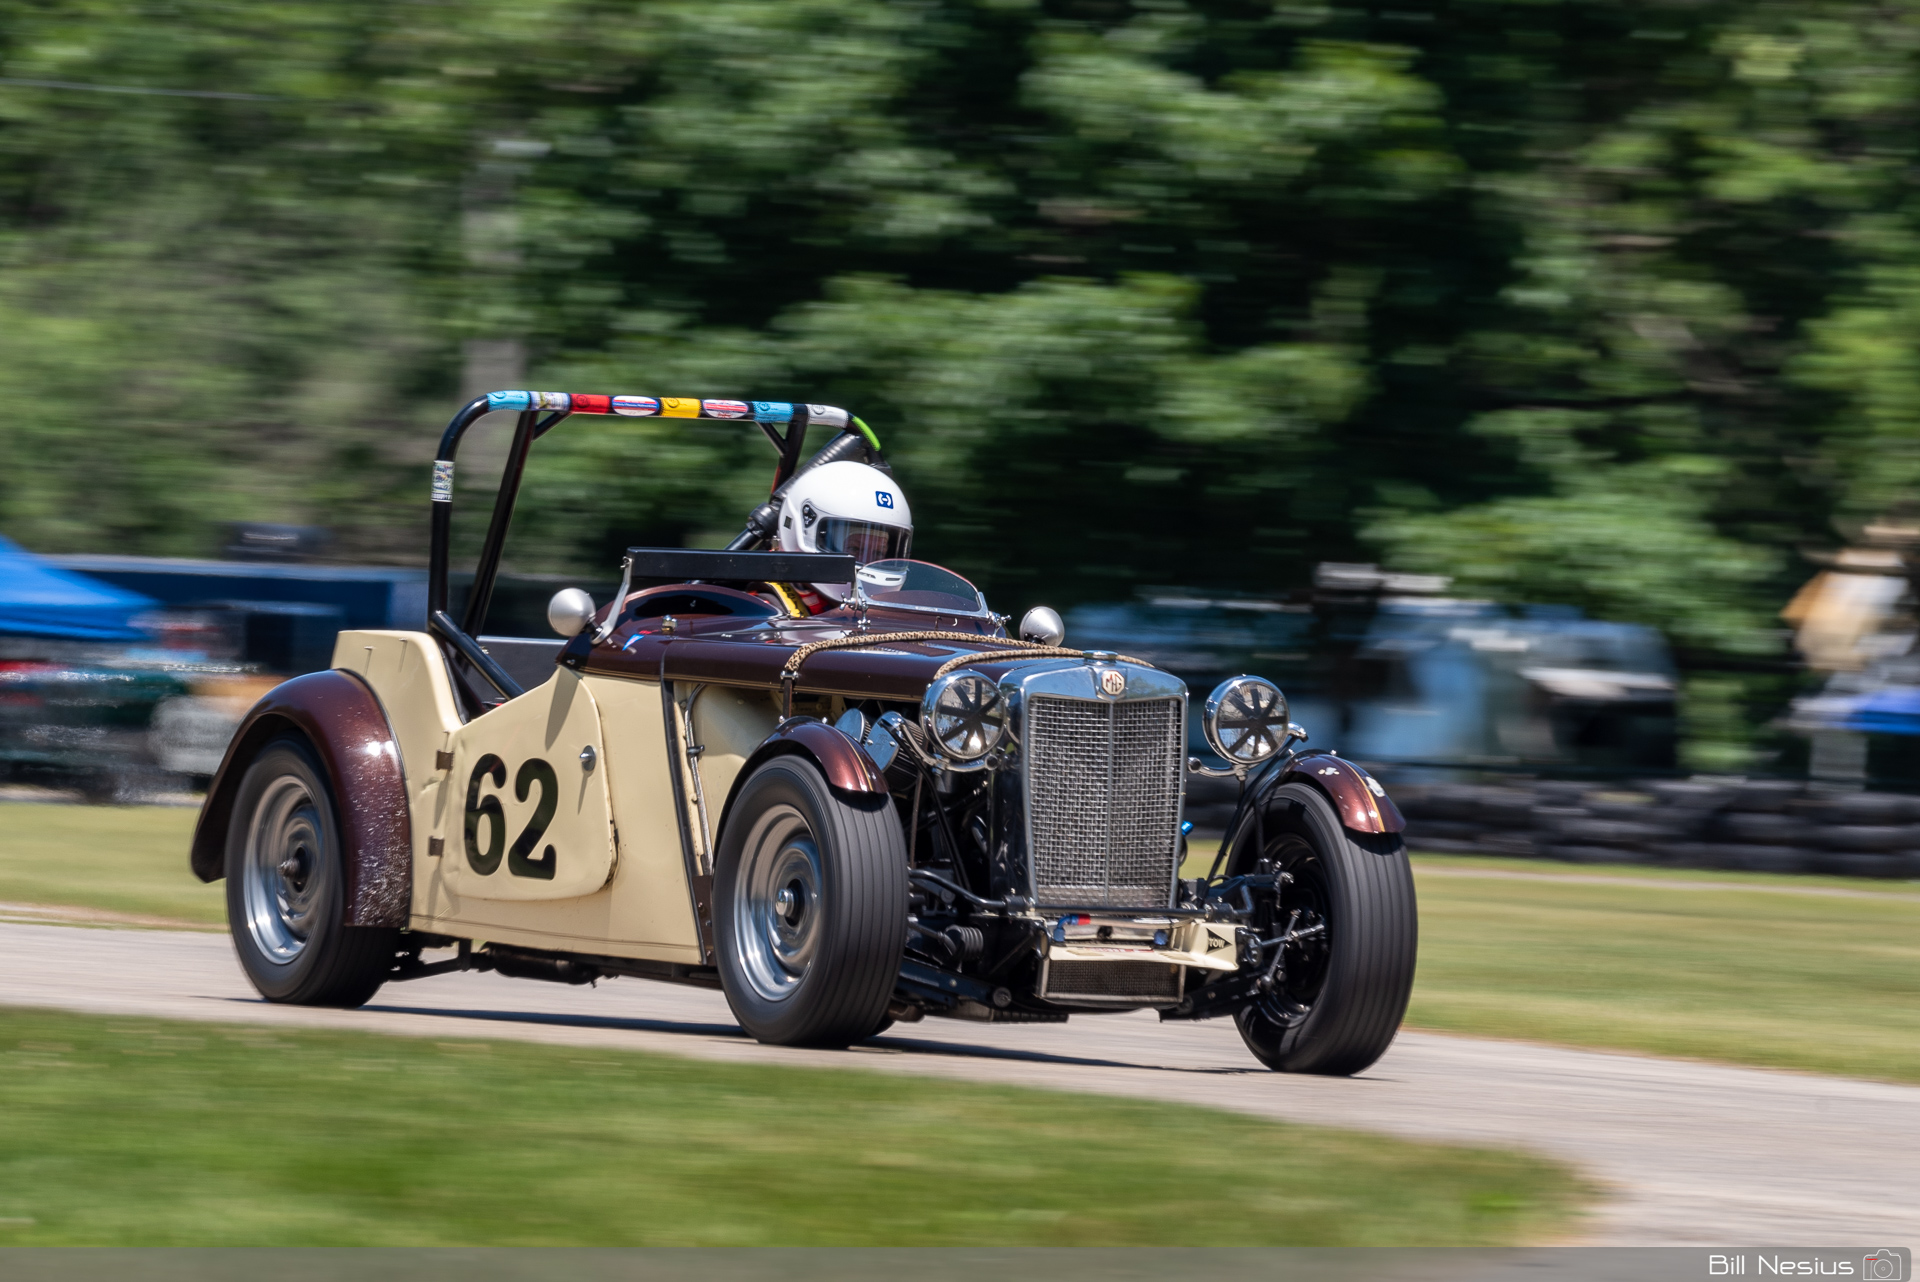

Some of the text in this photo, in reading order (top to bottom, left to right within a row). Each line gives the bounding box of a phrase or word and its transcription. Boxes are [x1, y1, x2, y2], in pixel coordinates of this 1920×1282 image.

[1105, 673, 1123, 693] MG
[464, 753, 559, 881] 62
[1208, 937, 1226, 949] TOW
